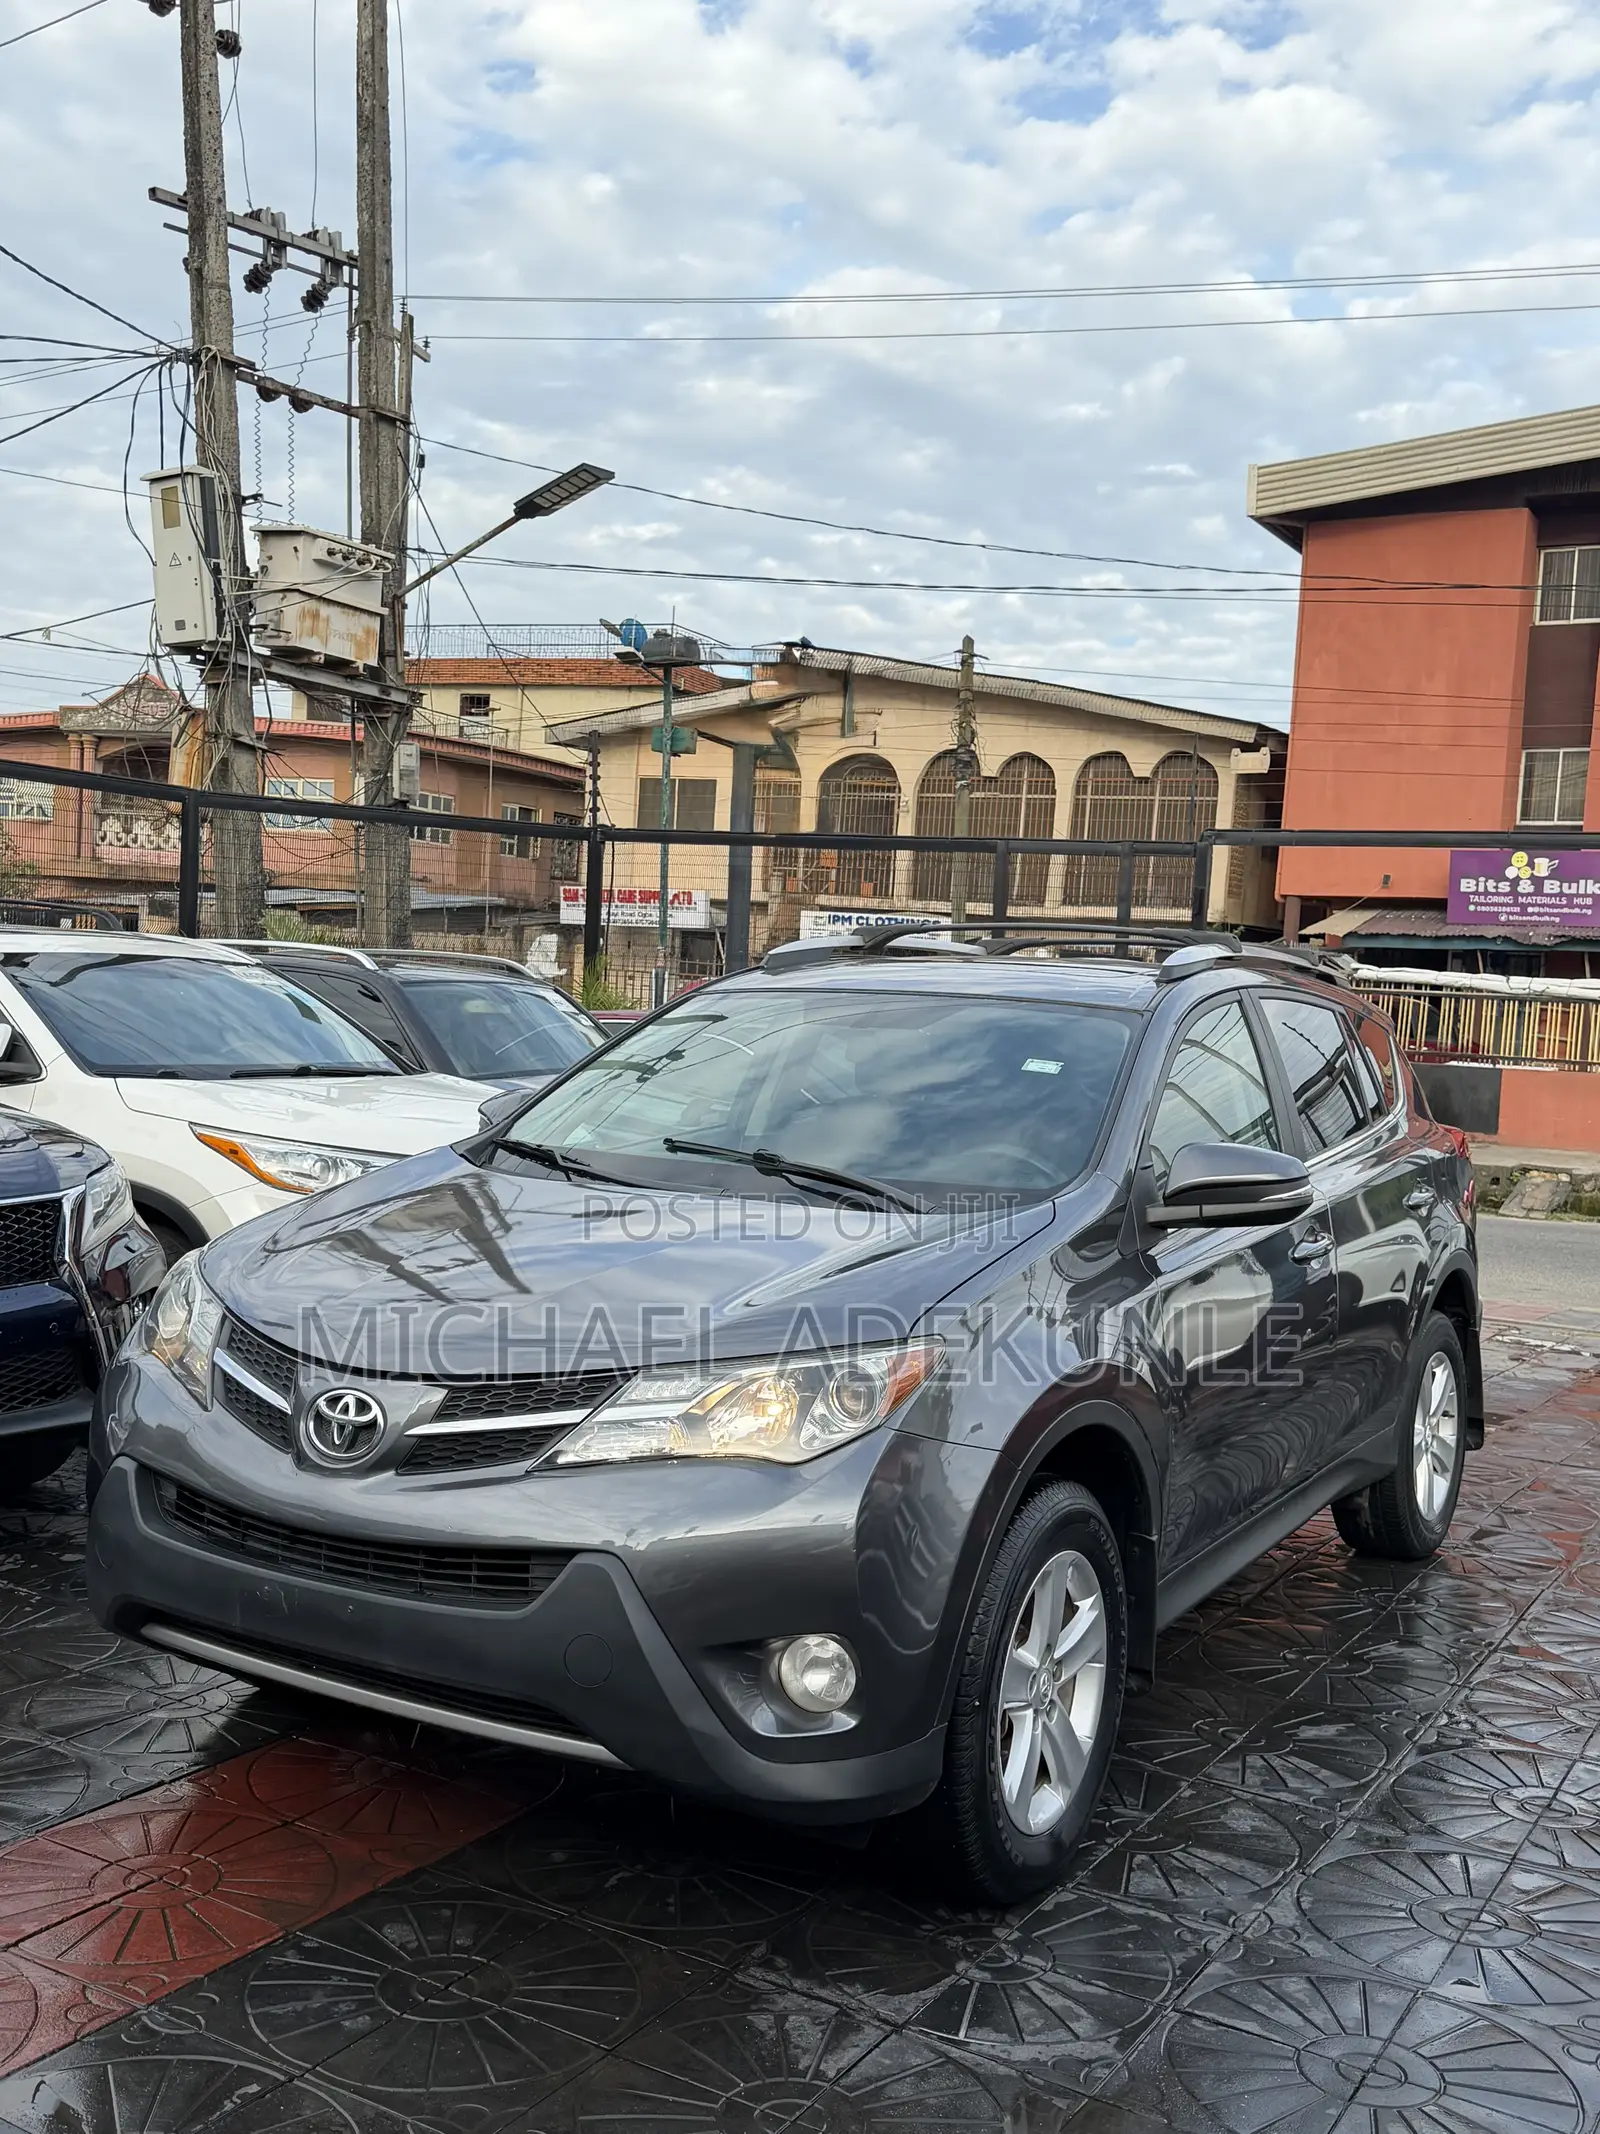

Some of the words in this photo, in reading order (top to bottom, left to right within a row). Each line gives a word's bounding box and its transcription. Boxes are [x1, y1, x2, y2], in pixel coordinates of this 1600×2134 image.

[1460, 877, 1511, 893] Bits
[1517, 879, 1535, 893] &
[1543, 879, 1600, 895] Bulk
[1469, 895, 1513, 904] TAILORING
[1518, 896, 1567, 905] MATERIALS
[1574, 897, 1592, 905] HUB
[828, 914, 852, 926] IPM
